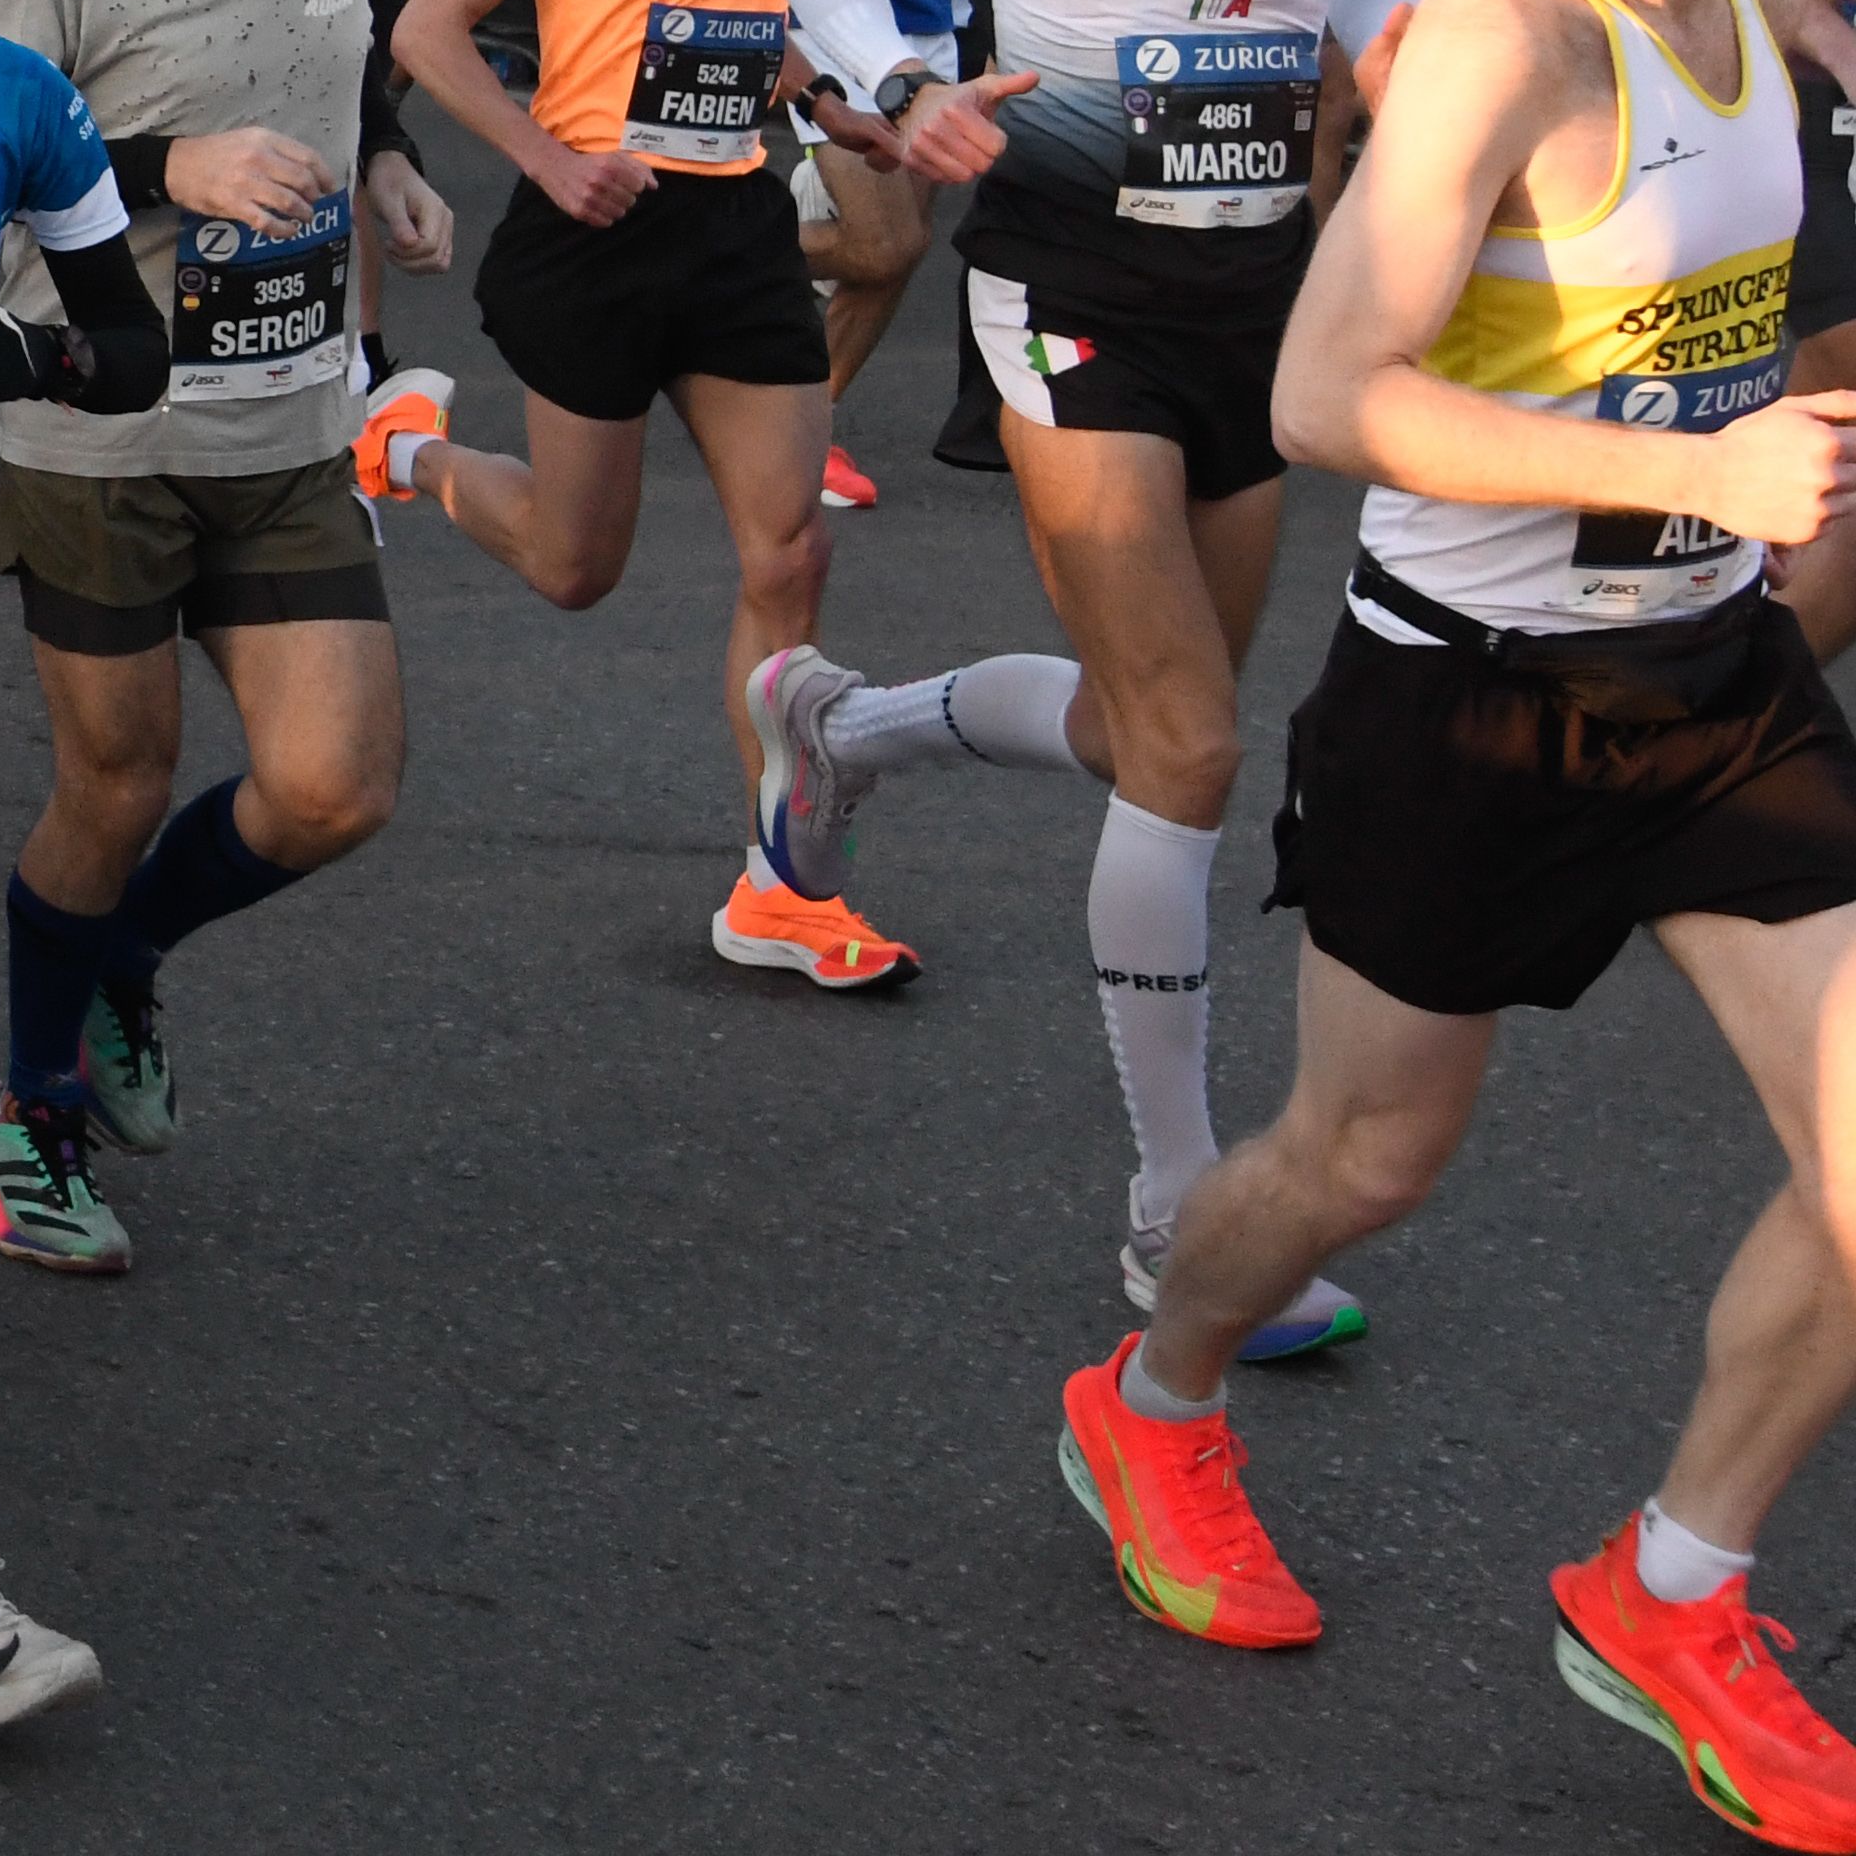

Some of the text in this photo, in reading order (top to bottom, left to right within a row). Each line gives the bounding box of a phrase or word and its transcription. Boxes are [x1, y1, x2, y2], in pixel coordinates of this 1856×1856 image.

[703, 19, 776, 41] ZURICH
[1194, 46, 1300, 71] ZURICH
[696, 63, 739, 86] 5242
[659, 90, 756, 126] FABIEN
[1198, 103, 1253, 129] 4861
[1162, 140, 1287, 183] MARCO
[253, 272, 306, 305] 3935
[210, 300, 326, 357] SERGIO
[196, 374, 224, 385] asics
[1601, 583, 1642, 596] asics
